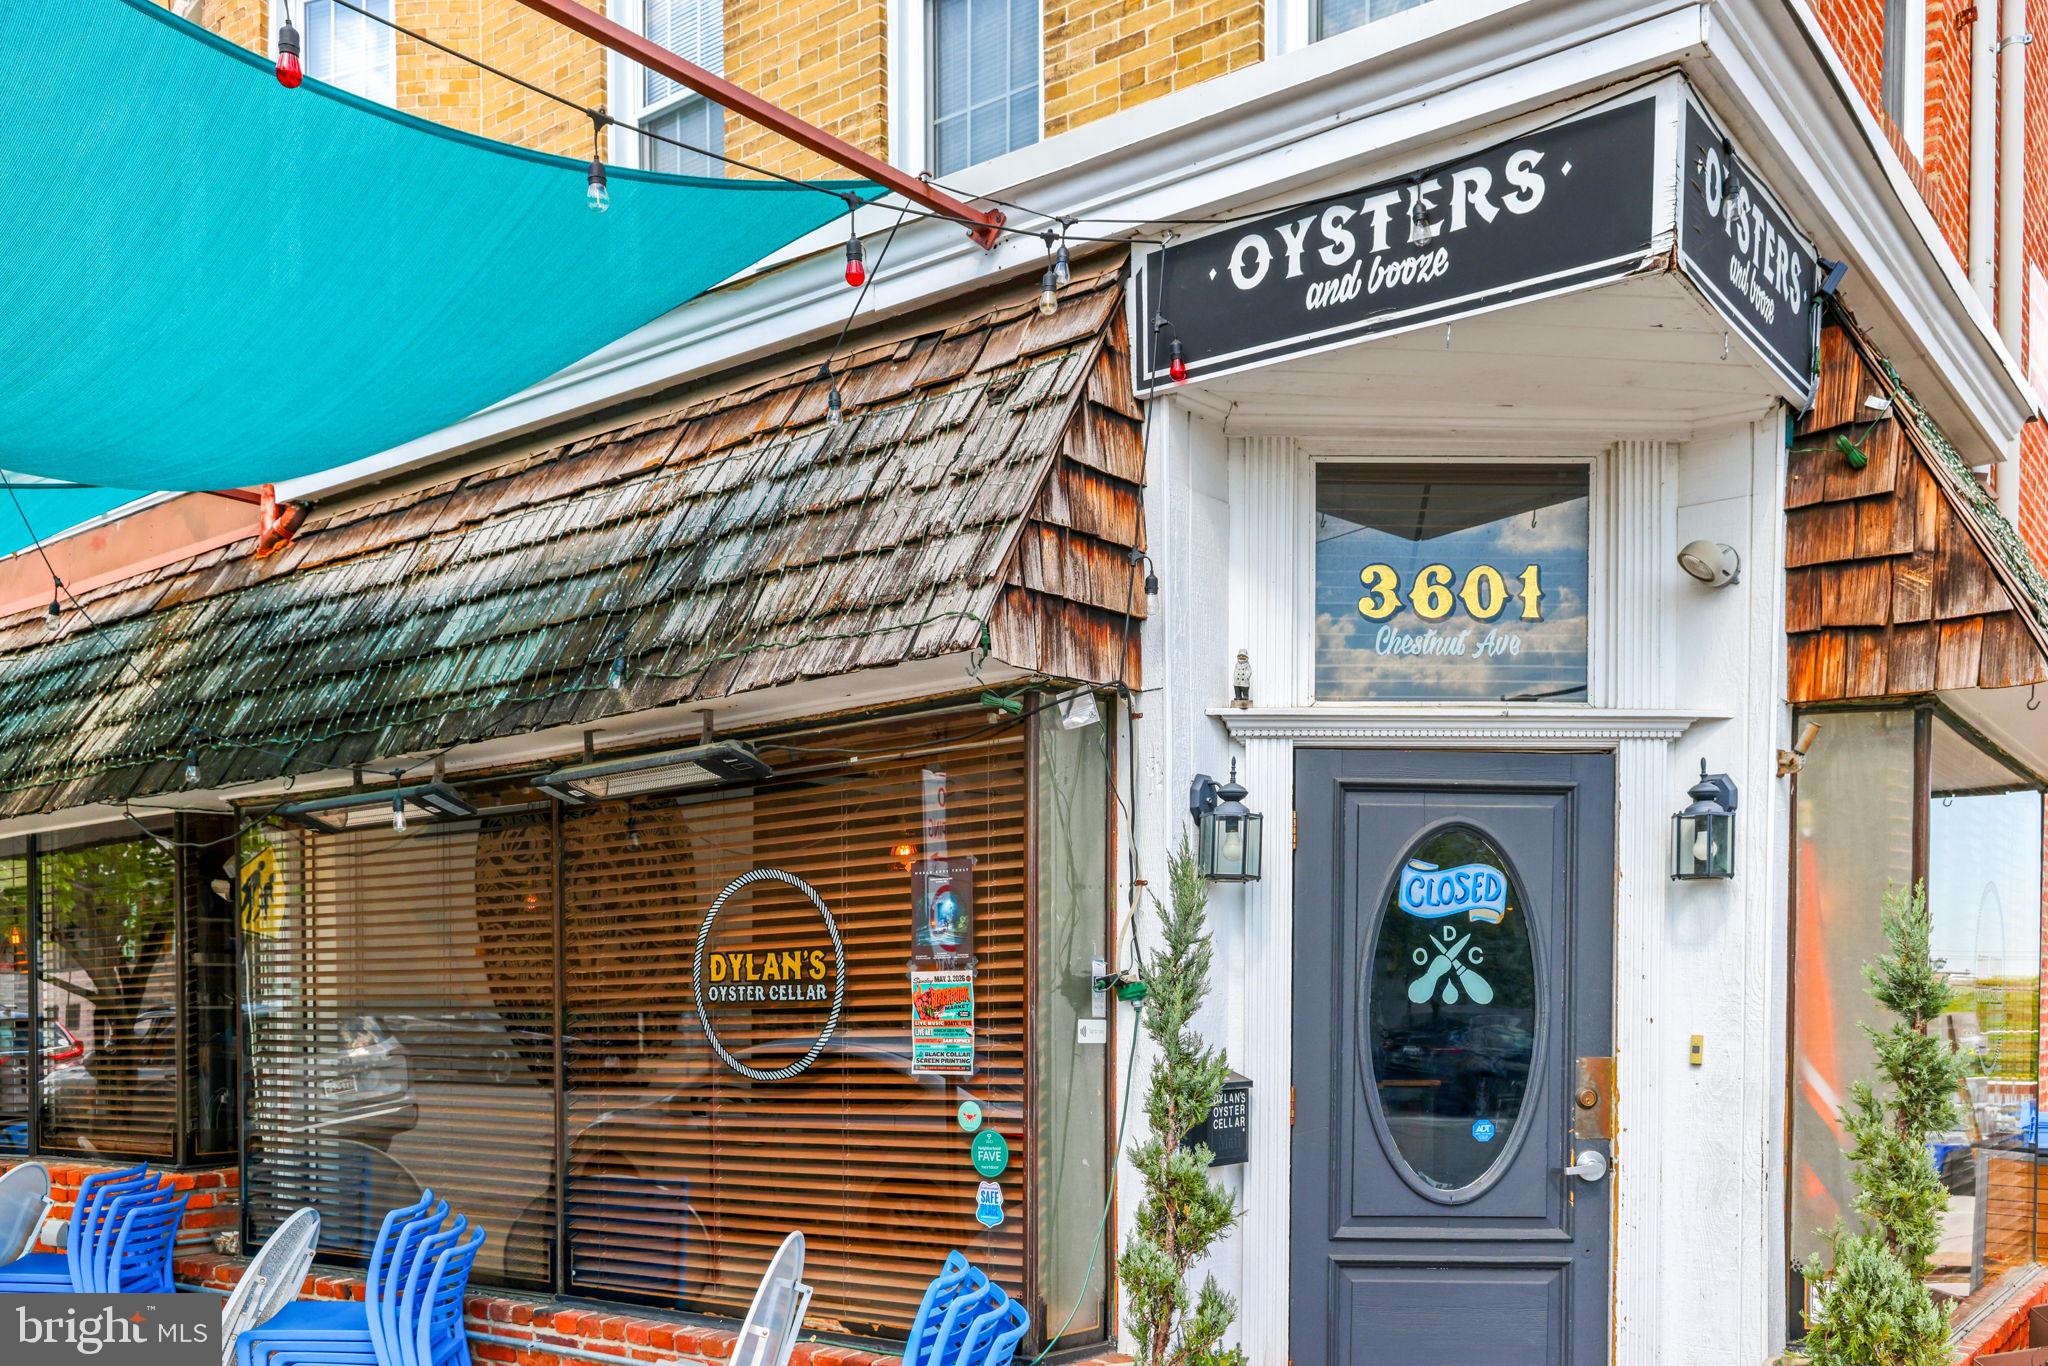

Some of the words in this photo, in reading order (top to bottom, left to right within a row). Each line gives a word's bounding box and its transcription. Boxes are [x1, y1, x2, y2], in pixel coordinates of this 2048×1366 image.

[1227, 149, 1545, 290] OYSTERS
[1306, 259, 1362, 311] and
[1367, 246, 1449, 294] booze
[1730, 254, 1751, 296] and
[1750, 267, 1775, 325] booze
[1358, 562, 1545, 623] 3601
[1375, 625, 1471, 656] Chestnut
[1472, 628, 1521, 658] Ave
[1405, 871, 1502, 908] CLOSED
[1412, 947, 1428, 966] O
[1443, 925, 1457, 942] D
[1468, 946, 1484, 964] C
[709, 950, 827, 982] DYLAN'S
[708, 985, 766, 1002] OYSTER
[769, 984, 828, 1001] CELLAR
[1213, 1092, 1246, 1105] DYLAN'S
[1213, 1104, 1245, 1118] OYSTER
[1213, 1116, 1245, 1130] CELLAR
[1476, 1124, 1491, 1132] ADT
[977, 1151, 1002, 1162] FAVE
[980, 1190, 999, 1204] SAFE
[980, 1203, 999, 1217] PLACE
